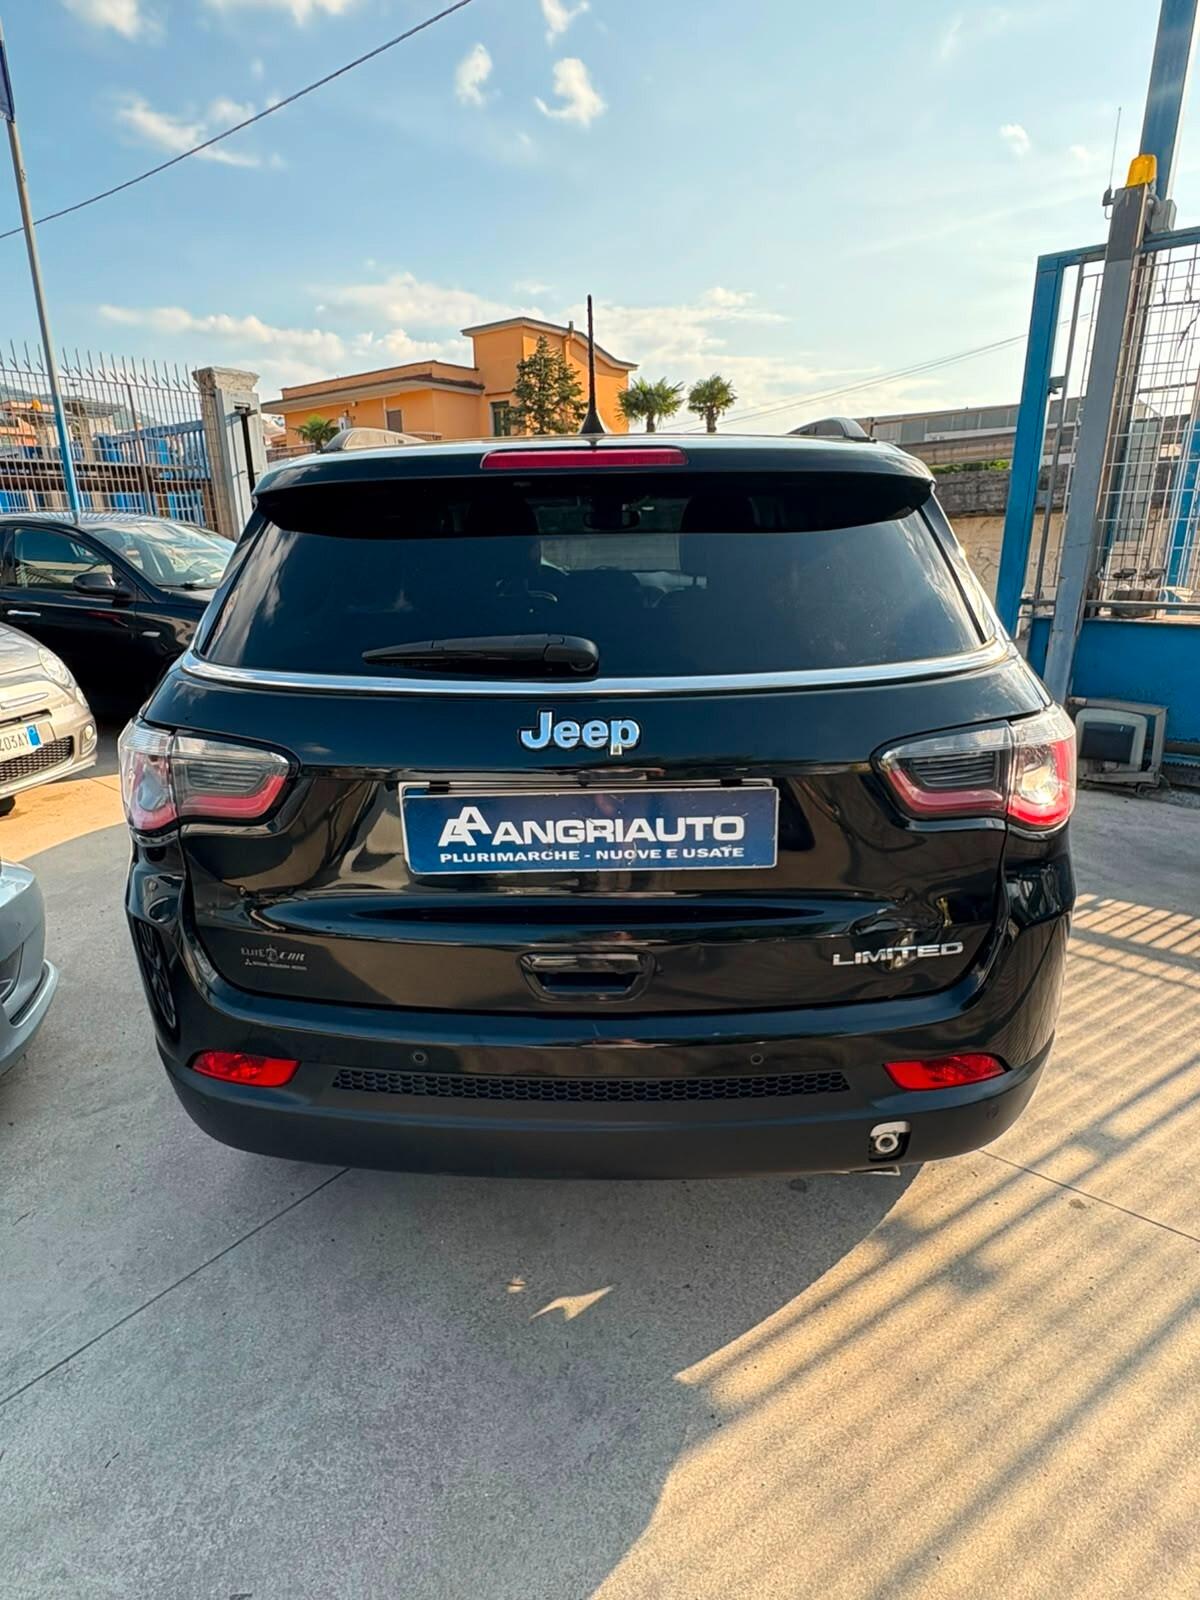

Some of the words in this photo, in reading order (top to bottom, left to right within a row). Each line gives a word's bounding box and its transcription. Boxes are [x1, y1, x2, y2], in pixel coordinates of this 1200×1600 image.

[520, 711, 641, 755] Jeep
[440, 850, 580, 863] PLURIMARCHE
[596, 849, 661, 861] NUOVE
[667, 849, 677, 860] E
[683, 847, 745, 859] USATE
[832, 941, 964, 967] LIMITED
